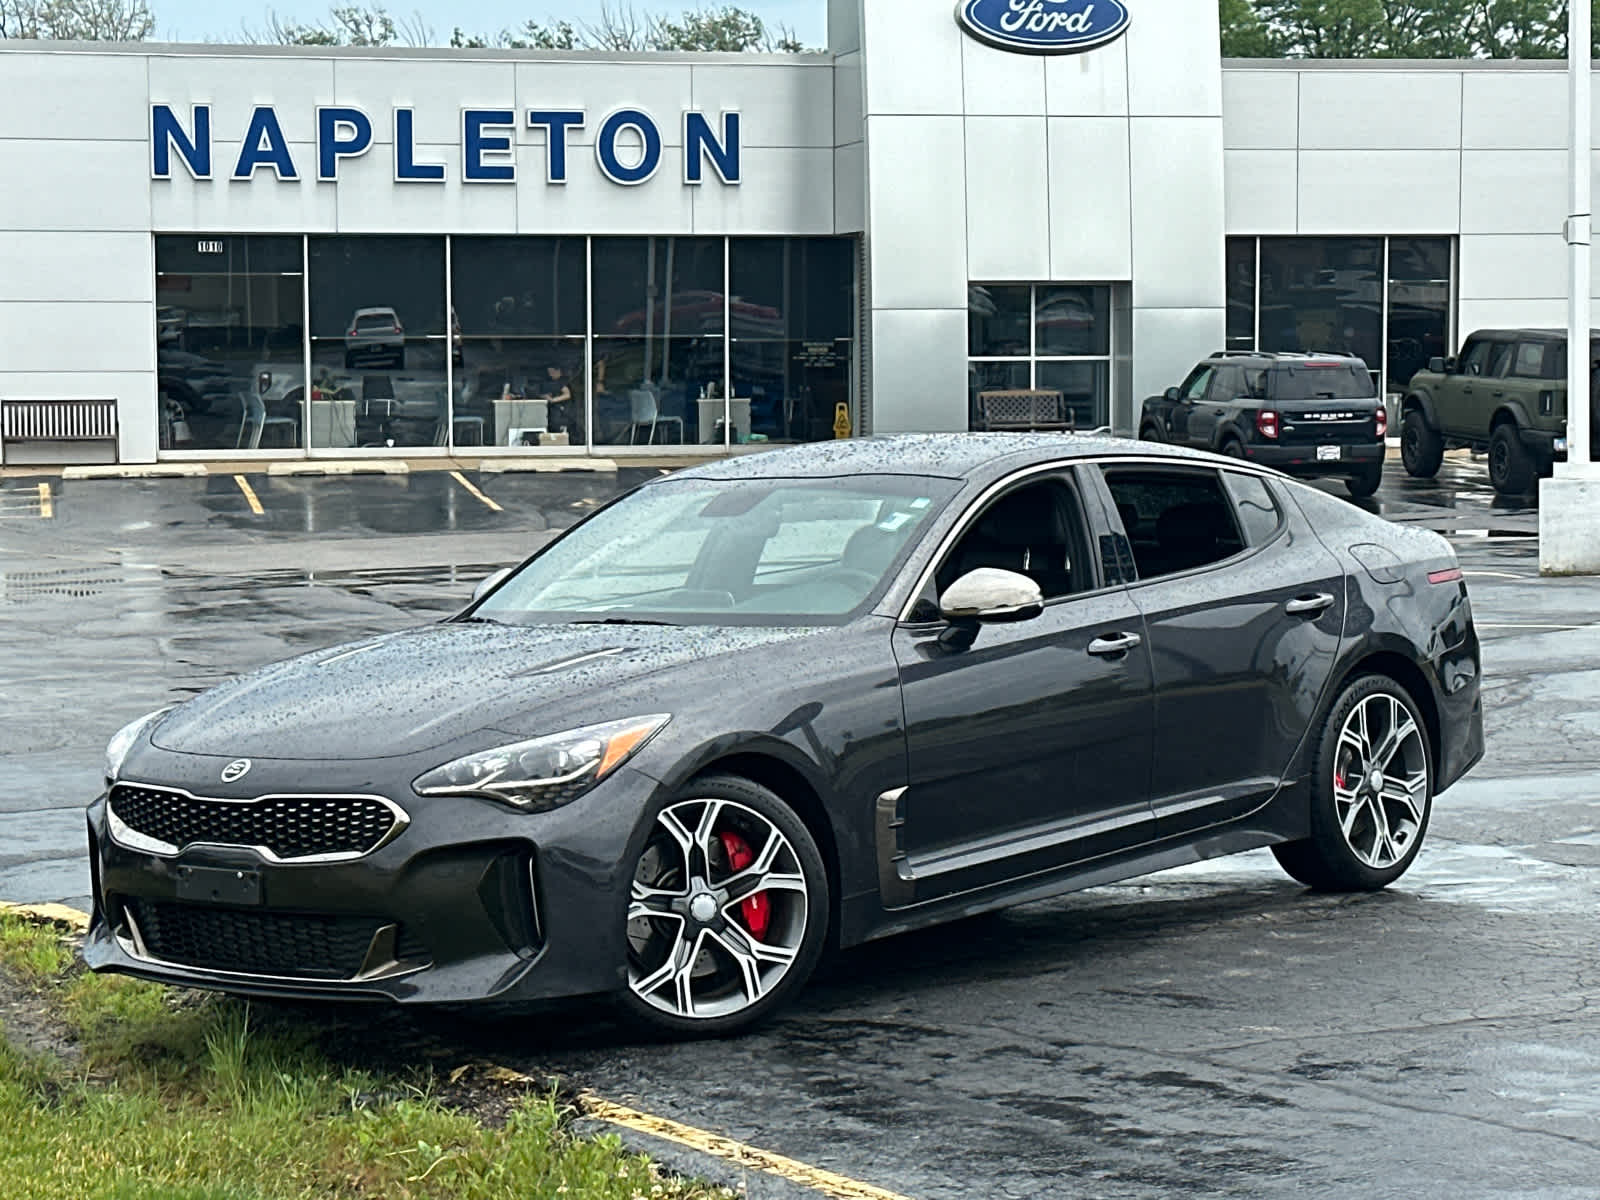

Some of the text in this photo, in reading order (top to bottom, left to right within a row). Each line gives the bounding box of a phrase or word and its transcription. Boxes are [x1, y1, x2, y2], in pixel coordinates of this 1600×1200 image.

[1000, 0, 1094, 32] Ford
[150, 103, 742, 185] NAPLETON
[197, 240, 223, 253] 1010
